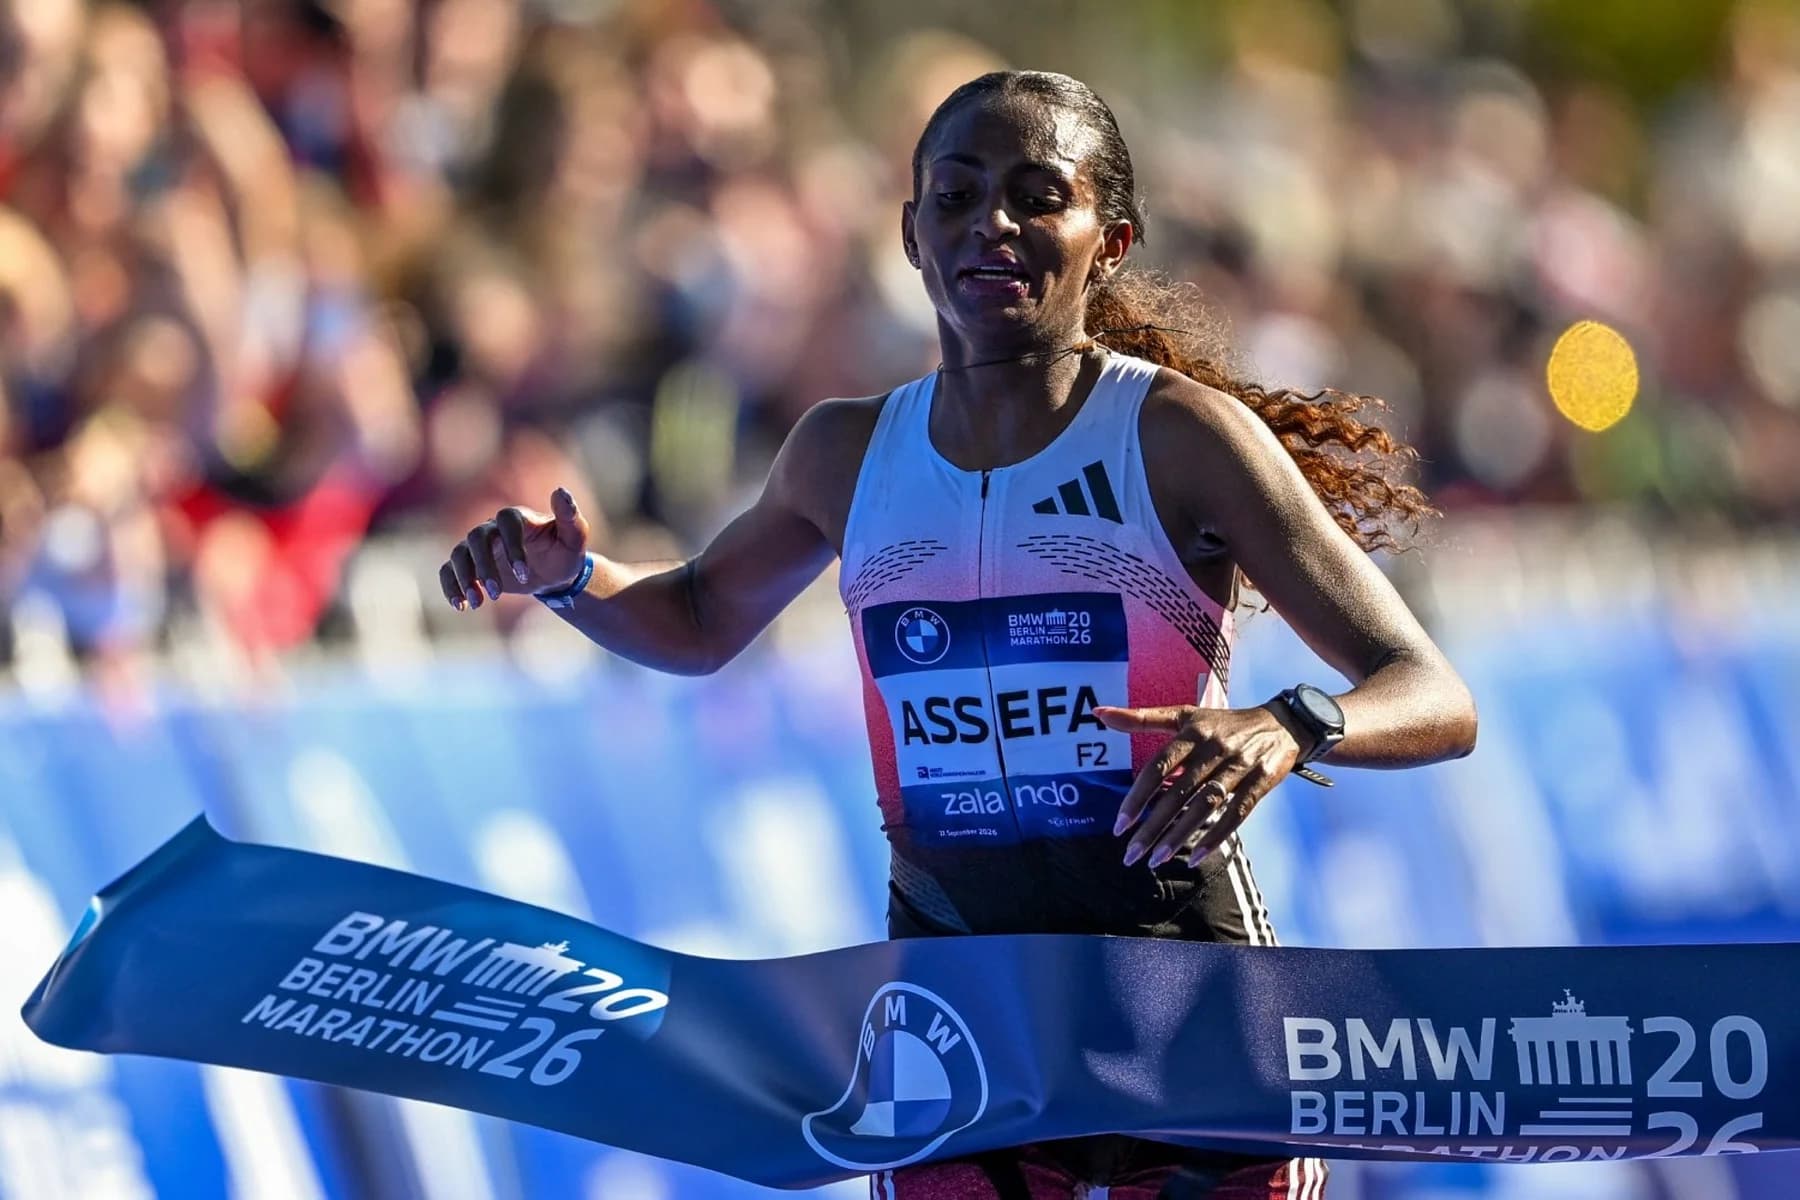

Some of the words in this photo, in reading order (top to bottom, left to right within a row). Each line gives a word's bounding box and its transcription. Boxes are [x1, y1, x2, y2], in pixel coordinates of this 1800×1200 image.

[900, 610, 941, 627] BMW
[1008, 612, 1044, 627] BMW
[1009, 626, 1046, 637] BERLIN
[1010, 635, 1068, 647] MARATHON
[1067, 611, 1091, 628] 20
[1069, 628, 1092, 645] 26
[901, 685, 1108, 746] ASSEFA
[1076, 742, 1109, 767] F2
[941, 780, 1080, 816] zalando
[978, 828, 998, 837] 2026
[313, 911, 494, 977] BMW
[279, 957, 445, 1016] BERLIN
[537, 968, 670, 1021] 20
[241, 993, 496, 1070] MARATHON
[479, 1016, 606, 1087] 26
[862, 994, 962, 1063] BMW
[1283, 1016, 1497, 1082] BMW
[1642, 1014, 1769, 1100] 20
[1290, 1090, 1506, 1136] BERLIN
[1633, 1110, 1764, 1160] 26
